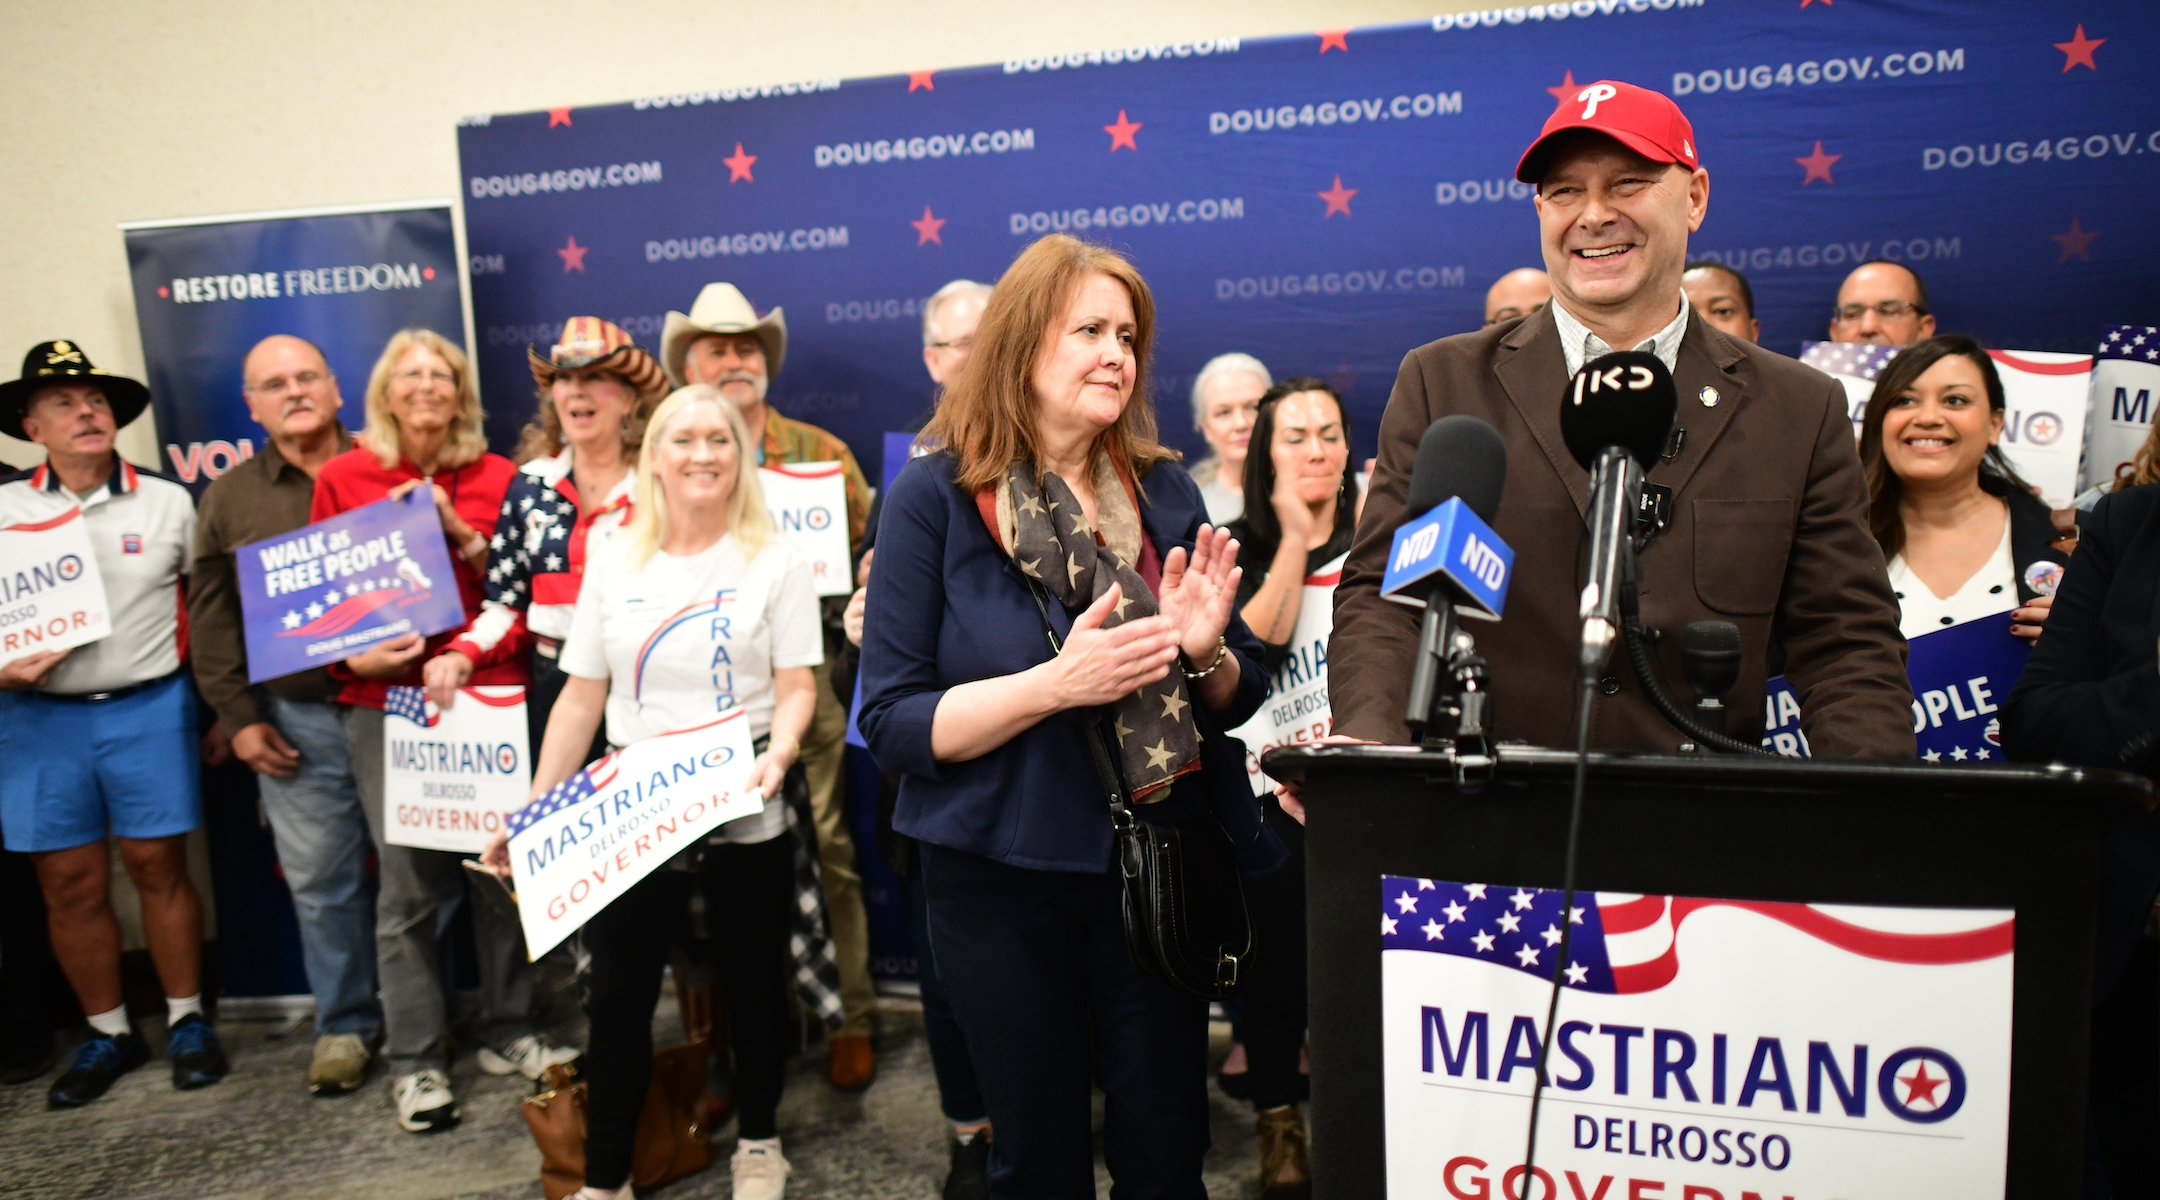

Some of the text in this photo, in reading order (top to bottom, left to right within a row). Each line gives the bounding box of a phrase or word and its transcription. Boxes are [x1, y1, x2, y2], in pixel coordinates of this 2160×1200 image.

[1673, 48, 1966, 96] DOUG4GOV.COM
[1209, 92, 1463, 134] DOUG4GOV.COM
[1578, 84, 1617, 120] P
[813, 129, 1035, 164] DOUG4GOV.COM
[471, 160, 663, 198] DOUG4GOV.COM
[1437, 178, 1537, 205] DOUG
[1010, 198, 1244, 234] DOUG4GOV.COM
[645, 226, 849, 262] DOUG4GOV.COM
[173, 263, 423, 303] RESTORE FREEDOM
[1216, 266, 1466, 300] DOUG4GOV.COM
[259, 528, 352, 571] WALK as
[264, 530, 407, 598] FREE PEOPLE
[1393, 522, 1440, 573] NTD
[1460, 532, 1506, 591] NTD
[391, 740, 517, 774] MASTRIANO
[423, 781, 476, 800] DELROSSO
[527, 746, 734, 876] MASTRIANO
[397, 803, 511, 833] GOVERNO
[590, 797, 671, 859] DELROSSO
[547, 791, 730, 920] GOVERNOR
[1420, 1004, 1966, 1124] MASTRIANO
[1574, 1114, 1791, 1171] DELROSSO
